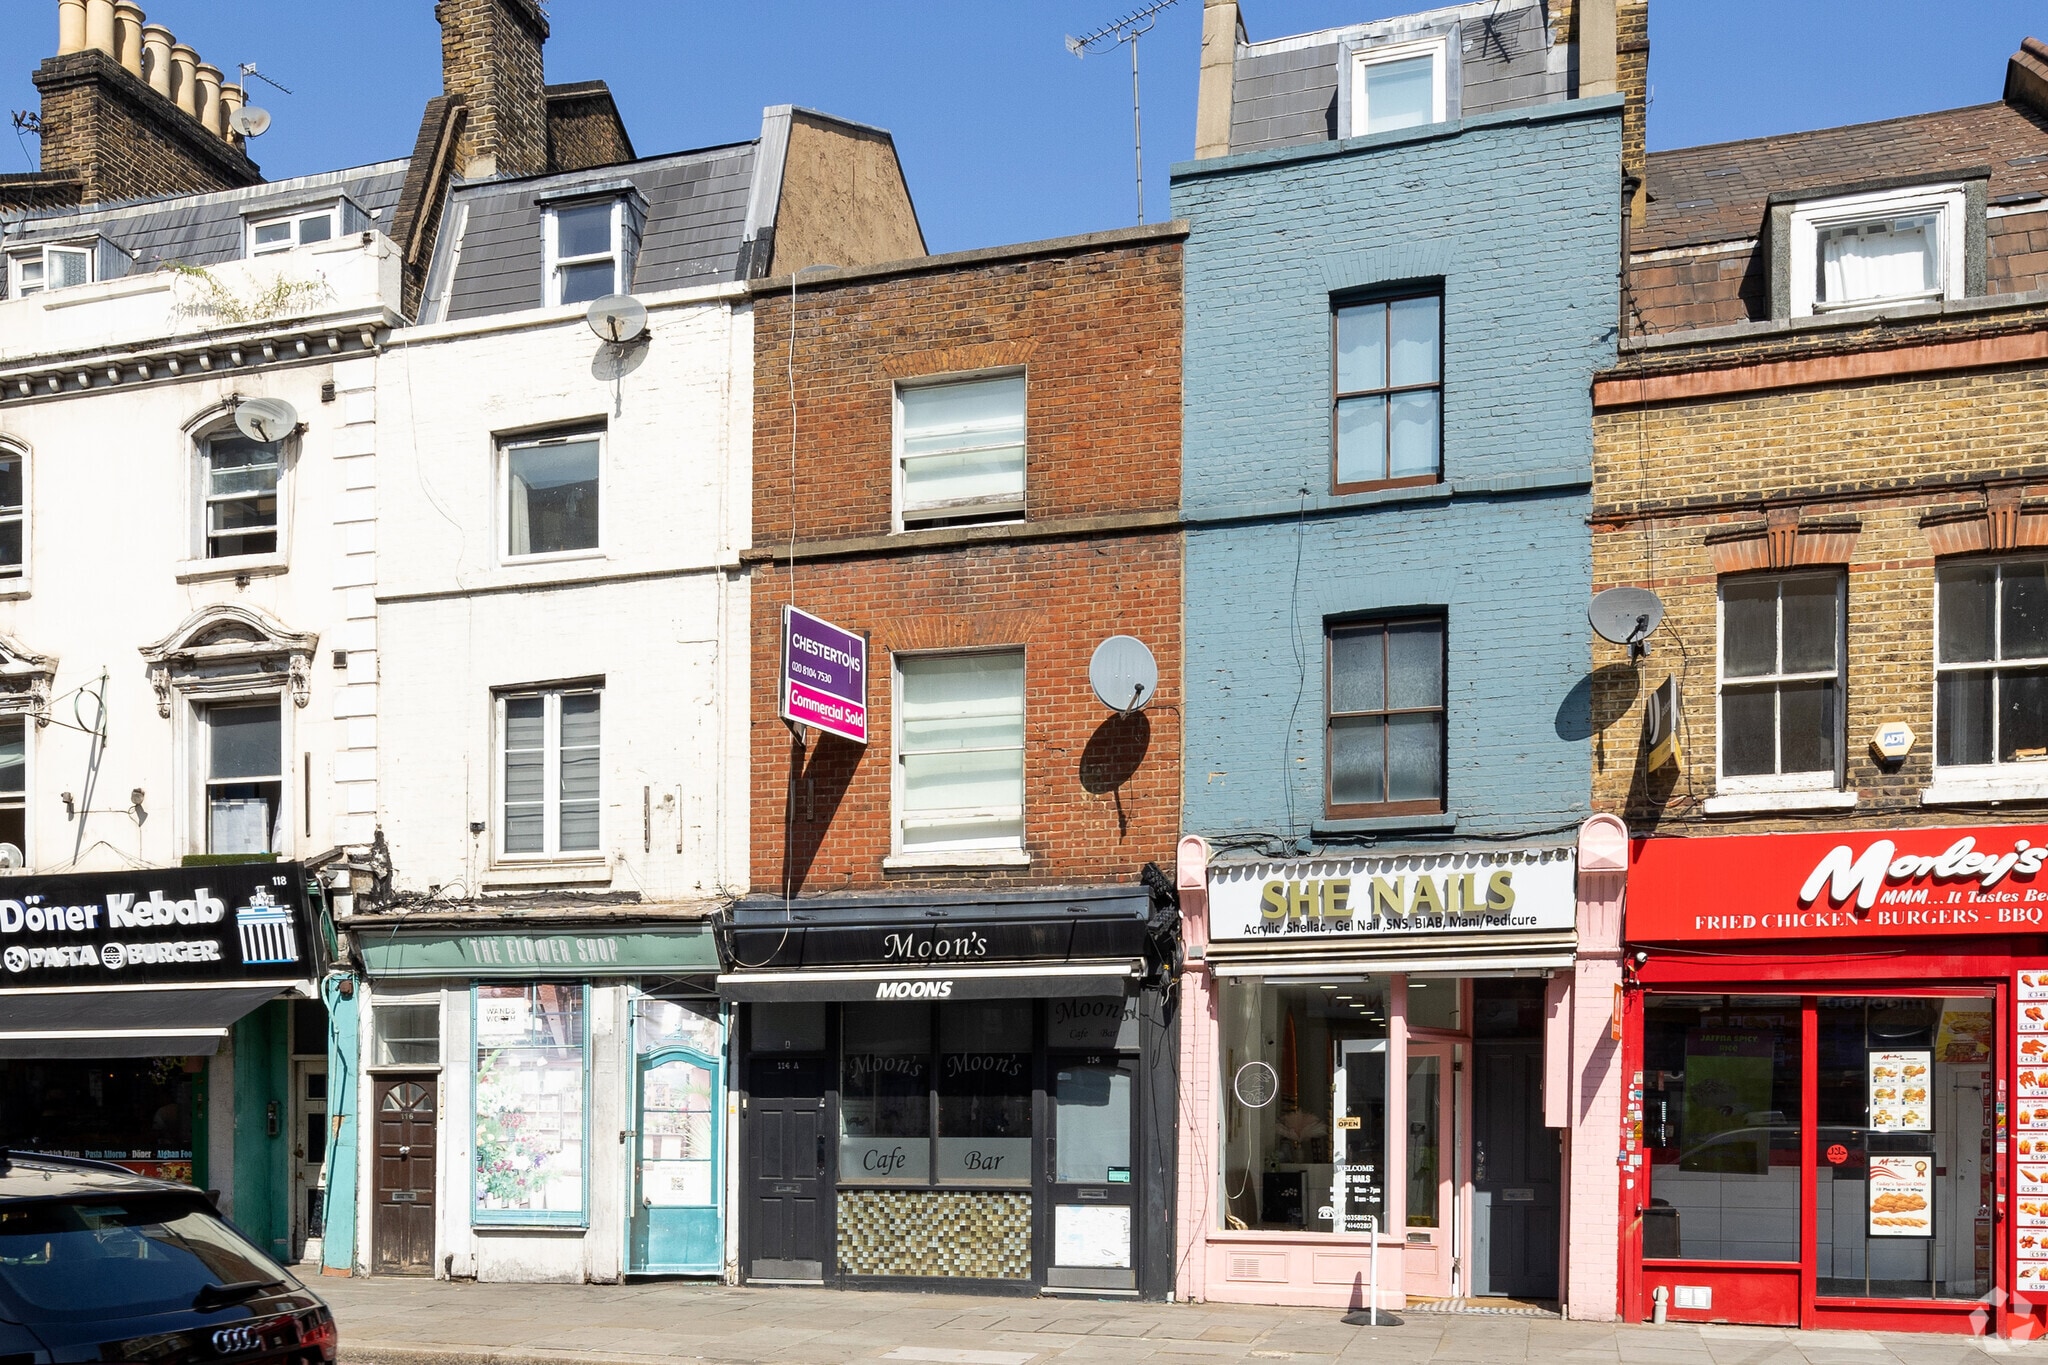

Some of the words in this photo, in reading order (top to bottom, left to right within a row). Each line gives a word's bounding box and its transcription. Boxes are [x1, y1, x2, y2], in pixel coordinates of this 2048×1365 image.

[792, 633, 861, 672] CHESTERTONS
[792, 661, 802, 673] 020
[802, 666, 817, 679] 8104
[817, 671, 832, 684] 7530
[791, 690, 843, 720] Commercial
[845, 708, 864, 728] Sold
[1884, 733, 1905, 745] ADT
[271, 876, 287, 887] 118
[1799, 836, 2048, 909] Morley's
[1263, 879, 1355, 919] SHE
[1371, 870, 1516, 914] NAILS
[1946, 891, 1962, 904] It
[1968, 890, 2019, 903] Tastes
[0, 895, 101, 933] Döner
[105, 888, 225, 928] Kebab
[1695, 914, 1757, 930] FRIED
[1762, 911, 1859, 929] CHICKEN
[1878, 907, 1979, 925] BURGERS
[1998, 907, 2043, 925] BBQ
[1244, 922, 1280, 936] Acrylic
[1335, 920, 1354, 931] Gel
[1357, 919, 1379, 930] Nail
[1450, 914, 1537, 929] Mani/Pedicure
[28, 945, 100, 968] PASTA
[126, 940, 221, 965] BURGER
[470, 939, 502, 964] THE
[506, 938, 572, 964] FLOWER
[576, 938, 618, 963] SHOP
[884, 931, 987, 959] Moon's
[876, 981, 953, 999] MOONS
[486, 1015, 516, 1023] WOH
[1056, 997, 1132, 1025] Moon's
[850, 1053, 923, 1078] Moon's
[947, 1052, 1022, 1077] Moon's
[85, 1150, 103, 1158] Pasta
[132, 1149, 151, 1158] Döner
[863, 1146, 906, 1175] Cafe
[964, 1150, 1004, 1170] Bar
[1352, 1175, 1371, 1183] NAILS
